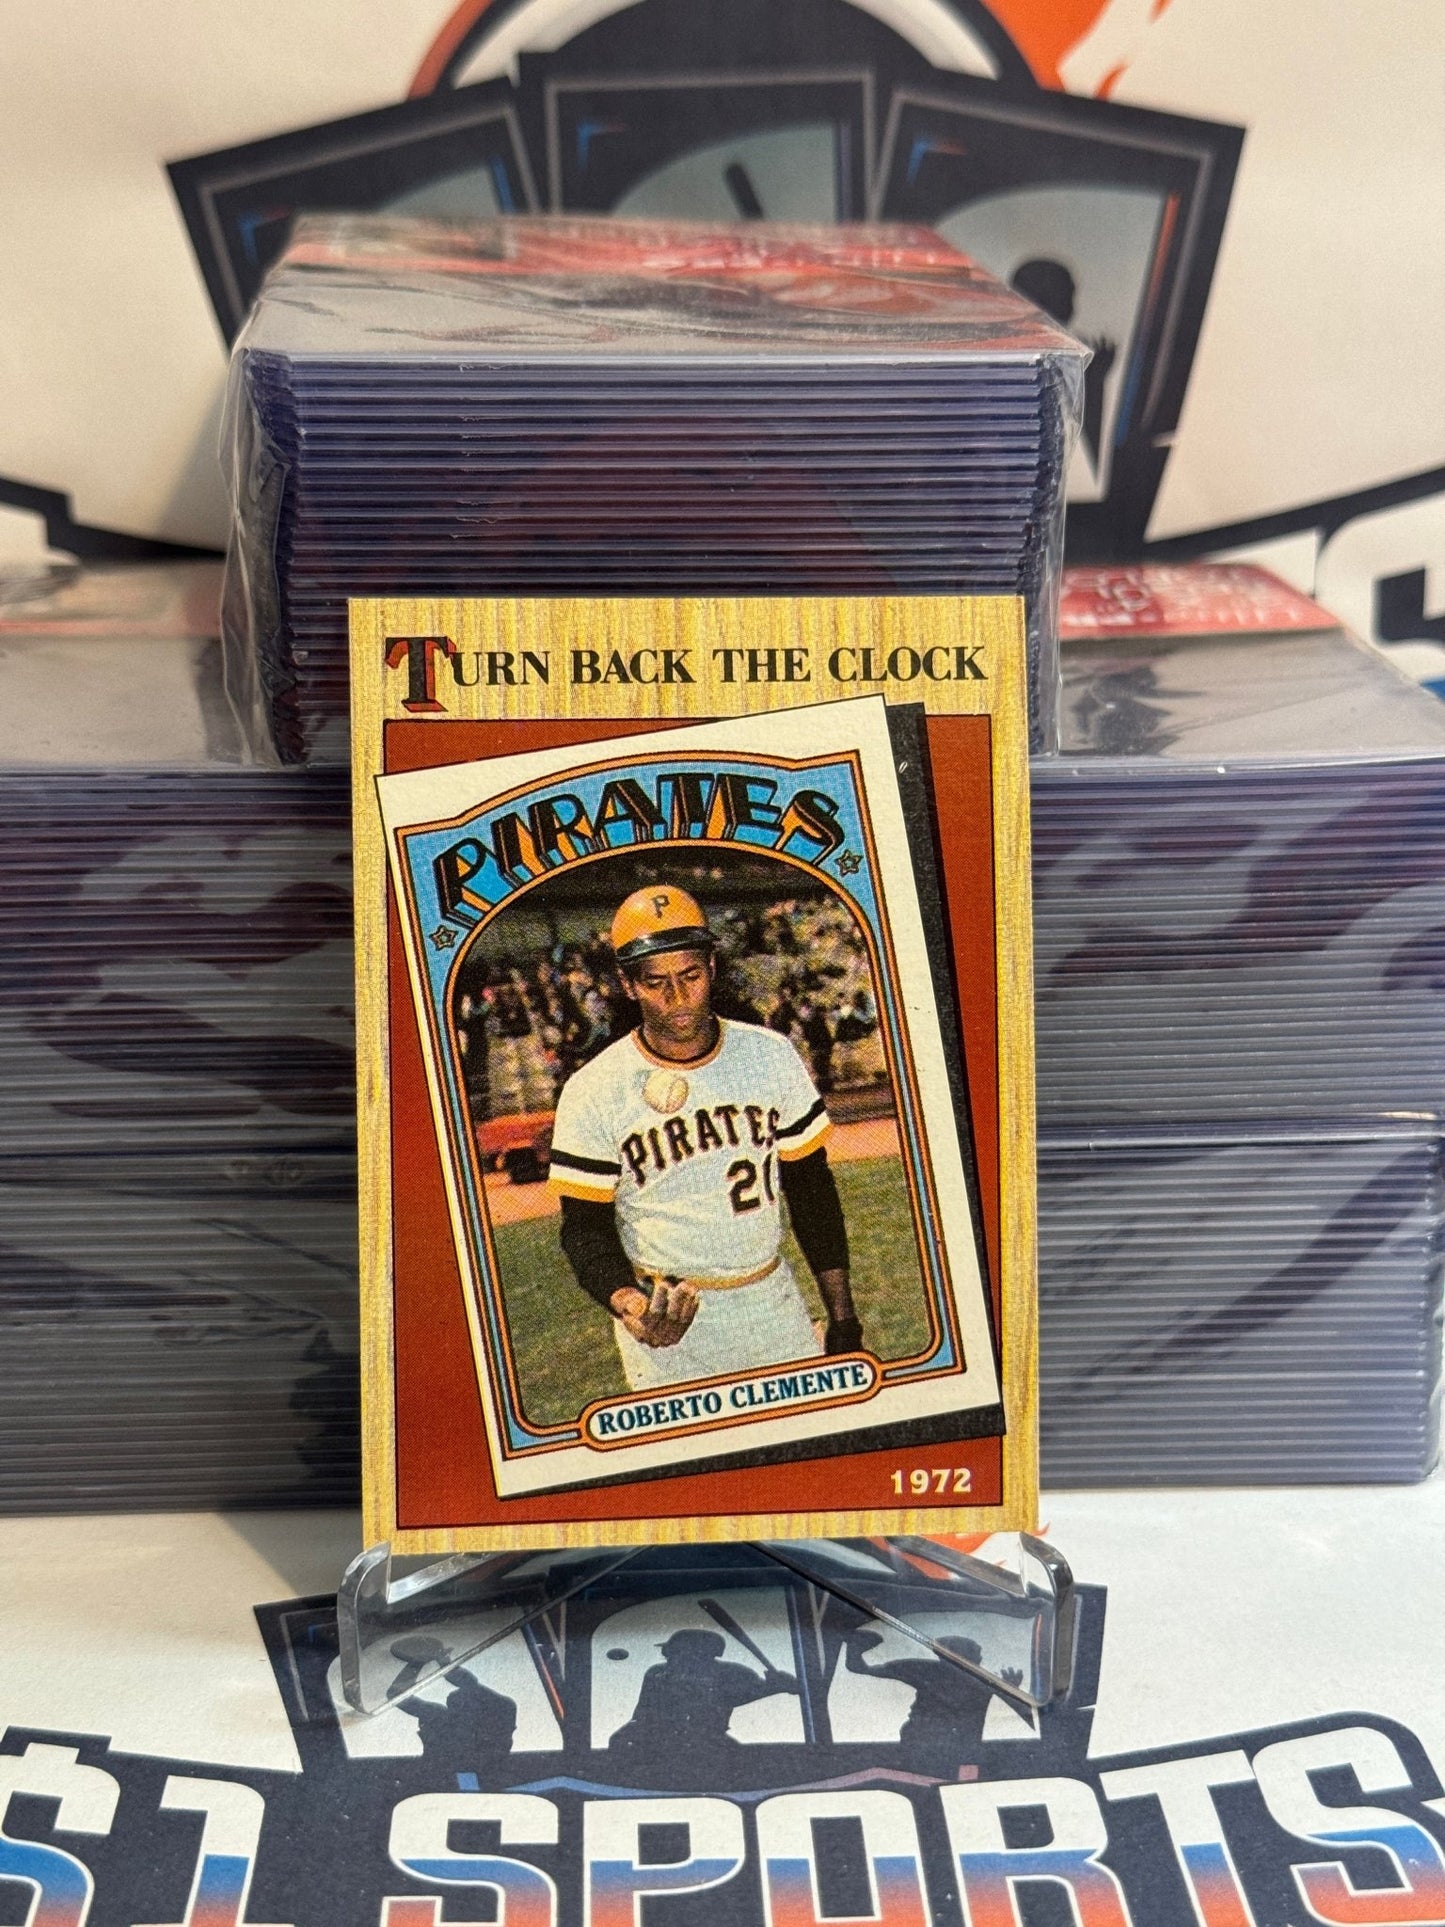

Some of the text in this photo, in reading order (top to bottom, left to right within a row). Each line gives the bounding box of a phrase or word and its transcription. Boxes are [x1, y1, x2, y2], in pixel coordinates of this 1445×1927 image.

[385, 636, 989, 713] TURN BACK THE CLOCK
[433, 772, 846, 928] PIRATES
[651, 894, 671, 919] P
[597, 1362, 869, 1436] ROBERTO CLEMENTE
[890, 1467, 973, 1495] 1972
[379, 1727, 1445, 1927] SPORTS
